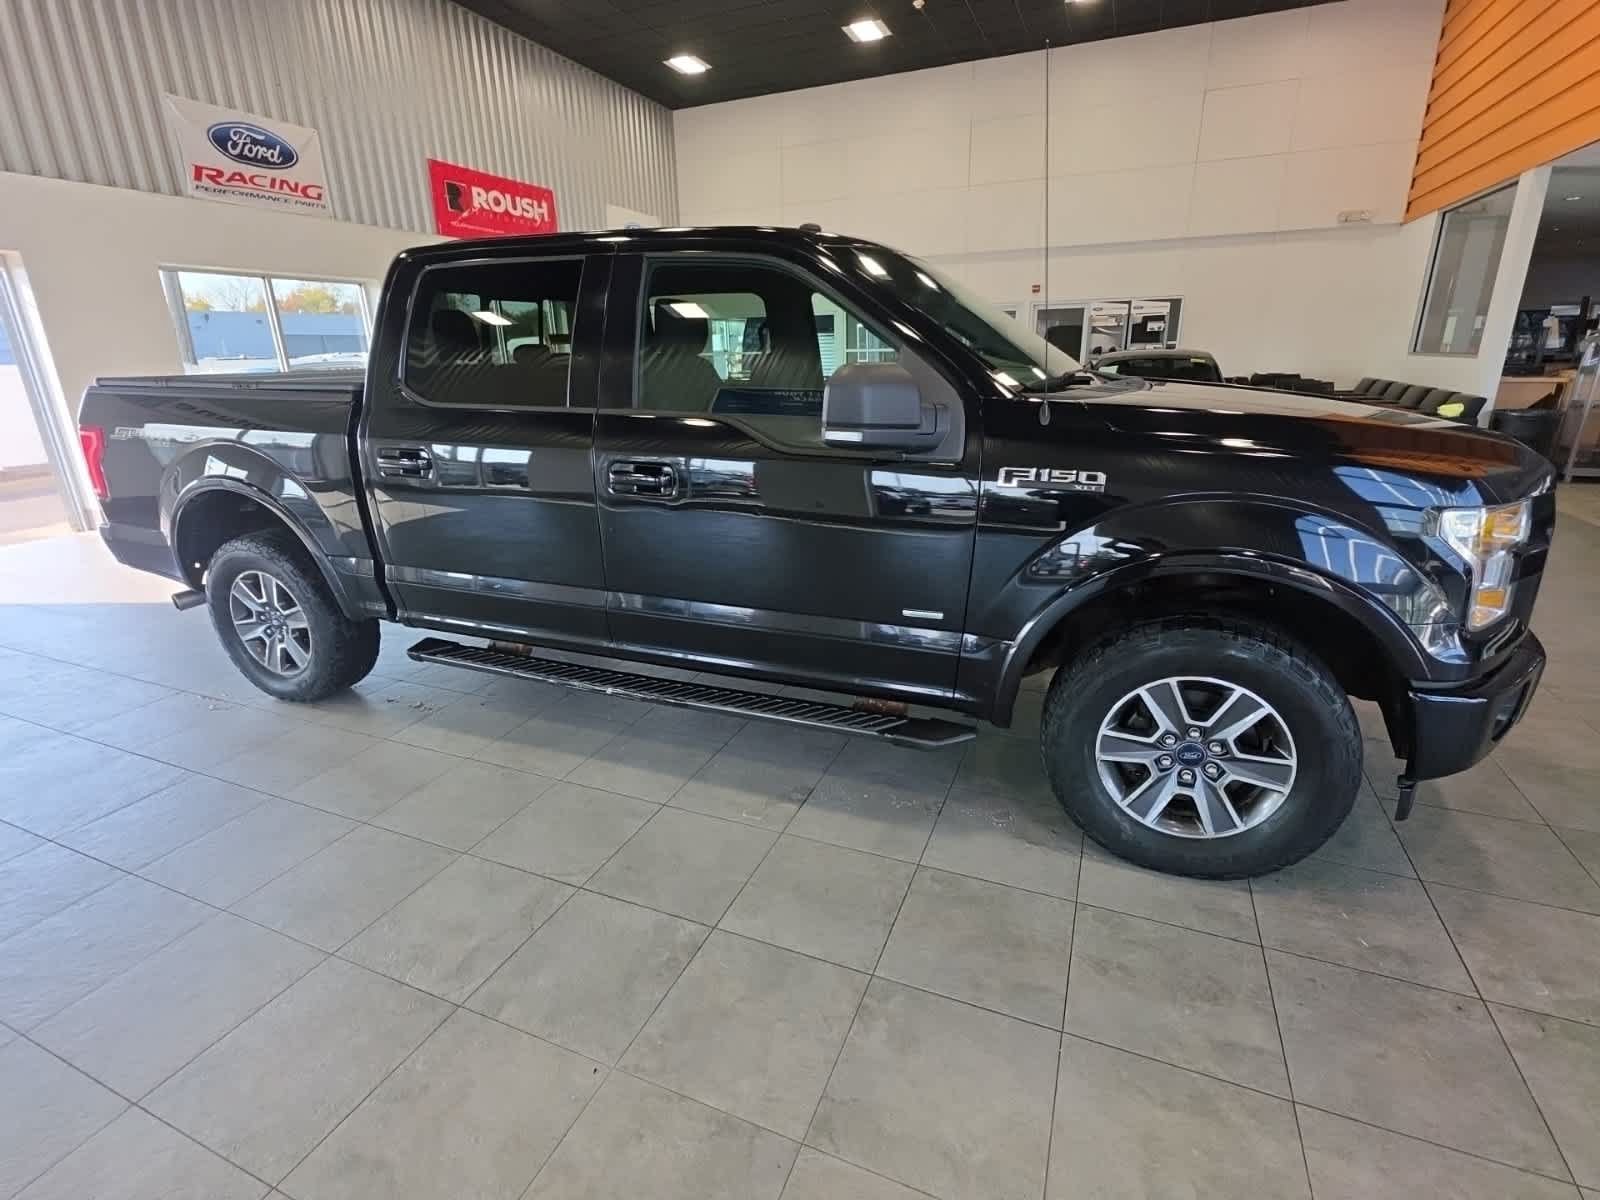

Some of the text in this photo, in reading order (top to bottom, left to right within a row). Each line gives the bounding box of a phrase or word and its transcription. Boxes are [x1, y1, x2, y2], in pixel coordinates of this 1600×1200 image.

[228, 128, 282, 163] Ford
[192, 164, 324, 200] RACING
[195, 184, 291, 204] PERFORMANCE
[471, 186, 549, 222] ROUSH
